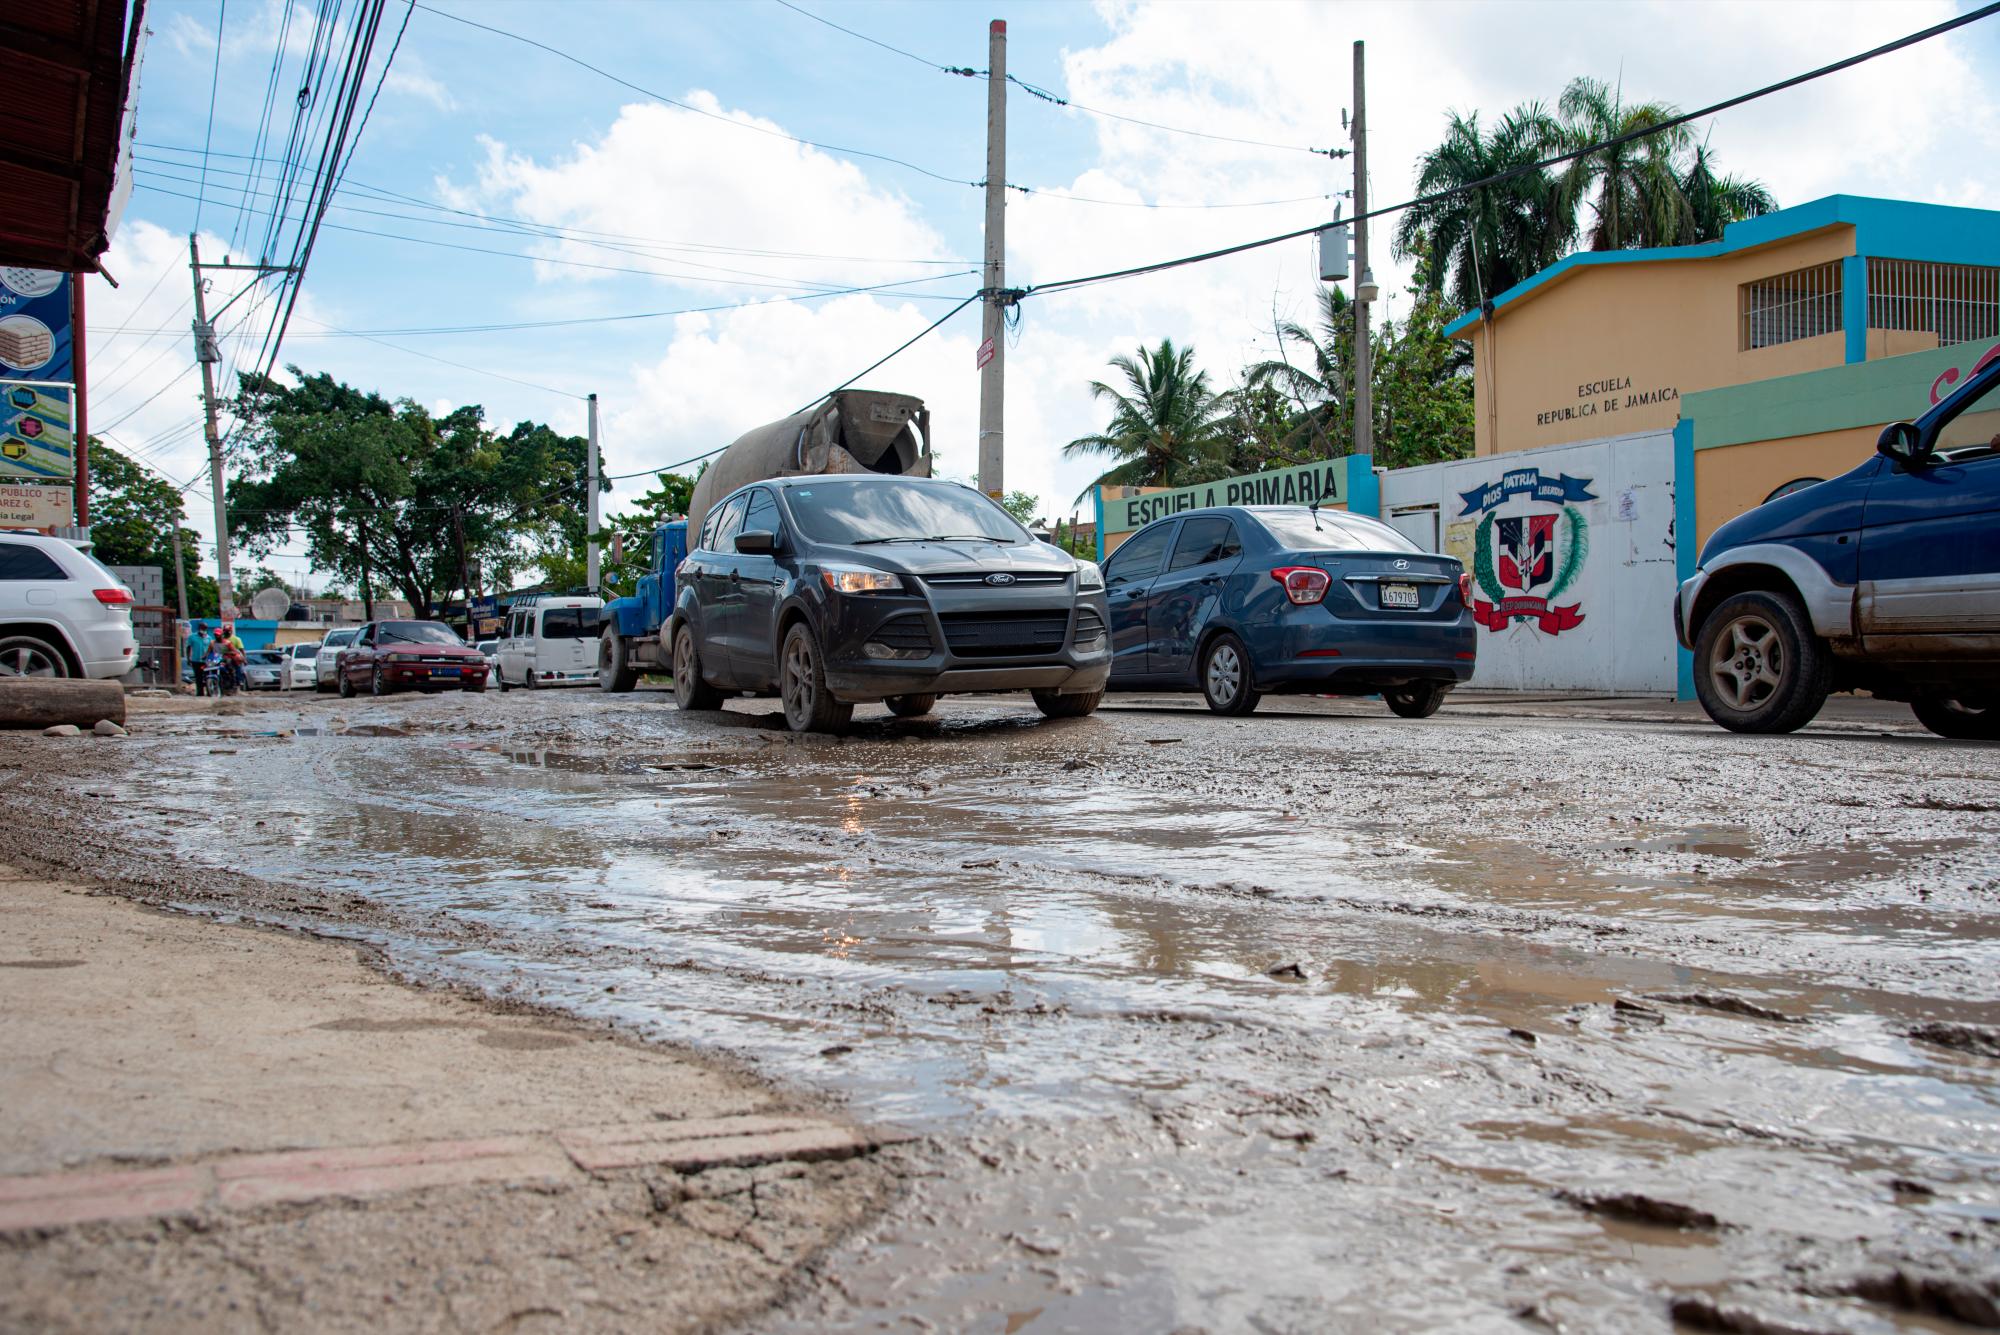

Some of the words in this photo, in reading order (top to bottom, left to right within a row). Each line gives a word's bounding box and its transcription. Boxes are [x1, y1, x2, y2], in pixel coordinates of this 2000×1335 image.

[1578, 376, 1631, 398] ESCUELA
[1537, 403, 1597, 426] REPUBLICA
[1604, 399, 1618, 413] DE
[1625, 388, 1679, 409] JAMAICA
[1, 488, 42, 498] PUBLICO
[1128, 488, 1215, 527] ESCUELA
[1227, 467, 1337, 506] PRIMARIA
[1482, 487, 1502, 507] DIOS
[1503, 472, 1538, 490] PATRIA
[11, 513, 34, 521] Legal
